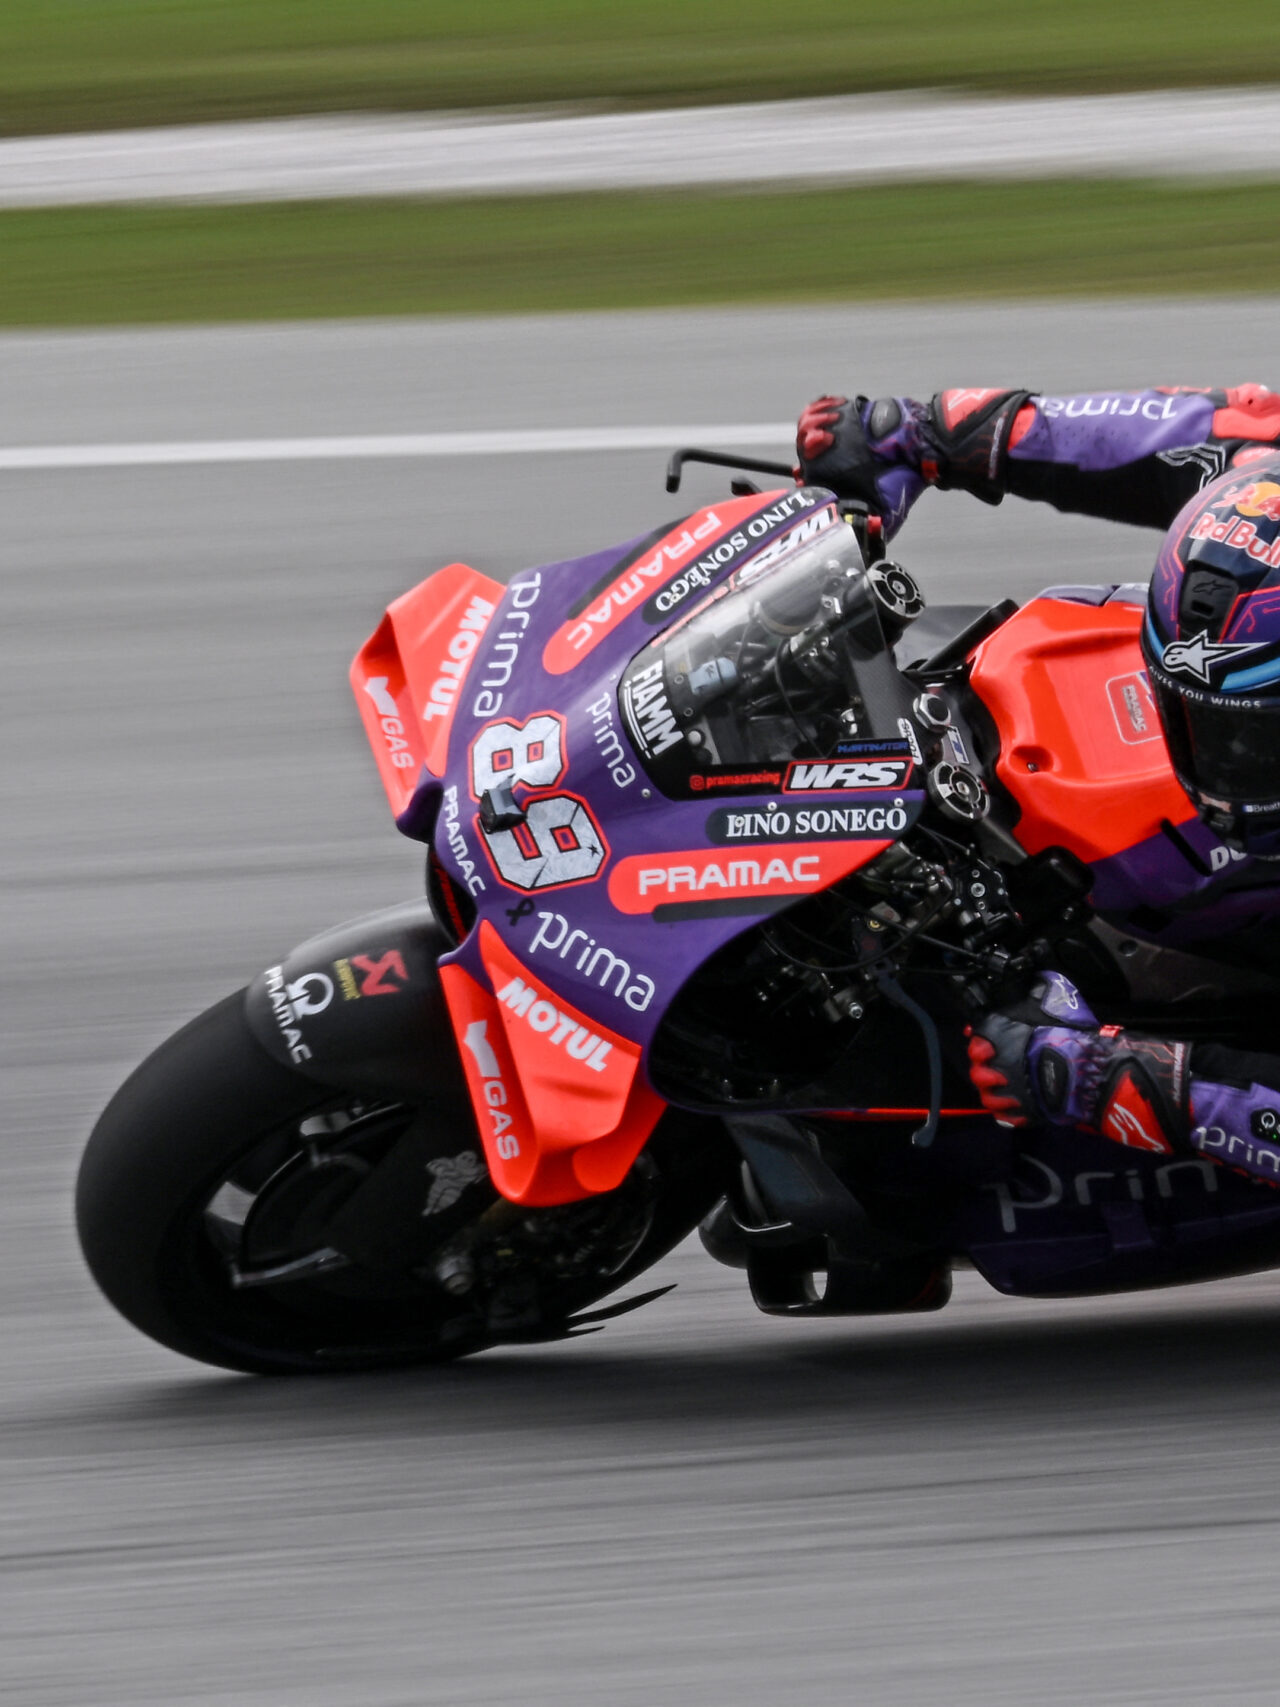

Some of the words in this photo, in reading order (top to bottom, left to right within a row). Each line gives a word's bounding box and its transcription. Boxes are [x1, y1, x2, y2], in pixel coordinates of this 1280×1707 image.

[748, 491, 816, 538] LINO
[566, 511, 722, 651] PRAMAC
[655, 531, 748, 612] SONEGO
[423, 594, 496, 722] MOTUL
[473, 571, 541, 718] prima
[586, 691, 637, 789] prima
[631, 659, 686, 757] FIAMM
[1178, 681, 1205, 702] YOU
[1211, 695, 1263, 709] WINGS
[469, 711, 610, 894] 89
[726, 812, 790, 838] LINO
[794, 806, 908, 836] SONEGO
[790, 760, 906, 790] WRS
[443, 784, 487, 897] PRAMAC
[638, 855, 821, 896] PRAMAC
[528, 910, 656, 1012] prima
[264, 965, 313, 1065] PRAMAC
[496, 976, 614, 1072] MOTUL
[484, 1080, 520, 1161] GAS
[979, 1153, 1218, 1234] prim
